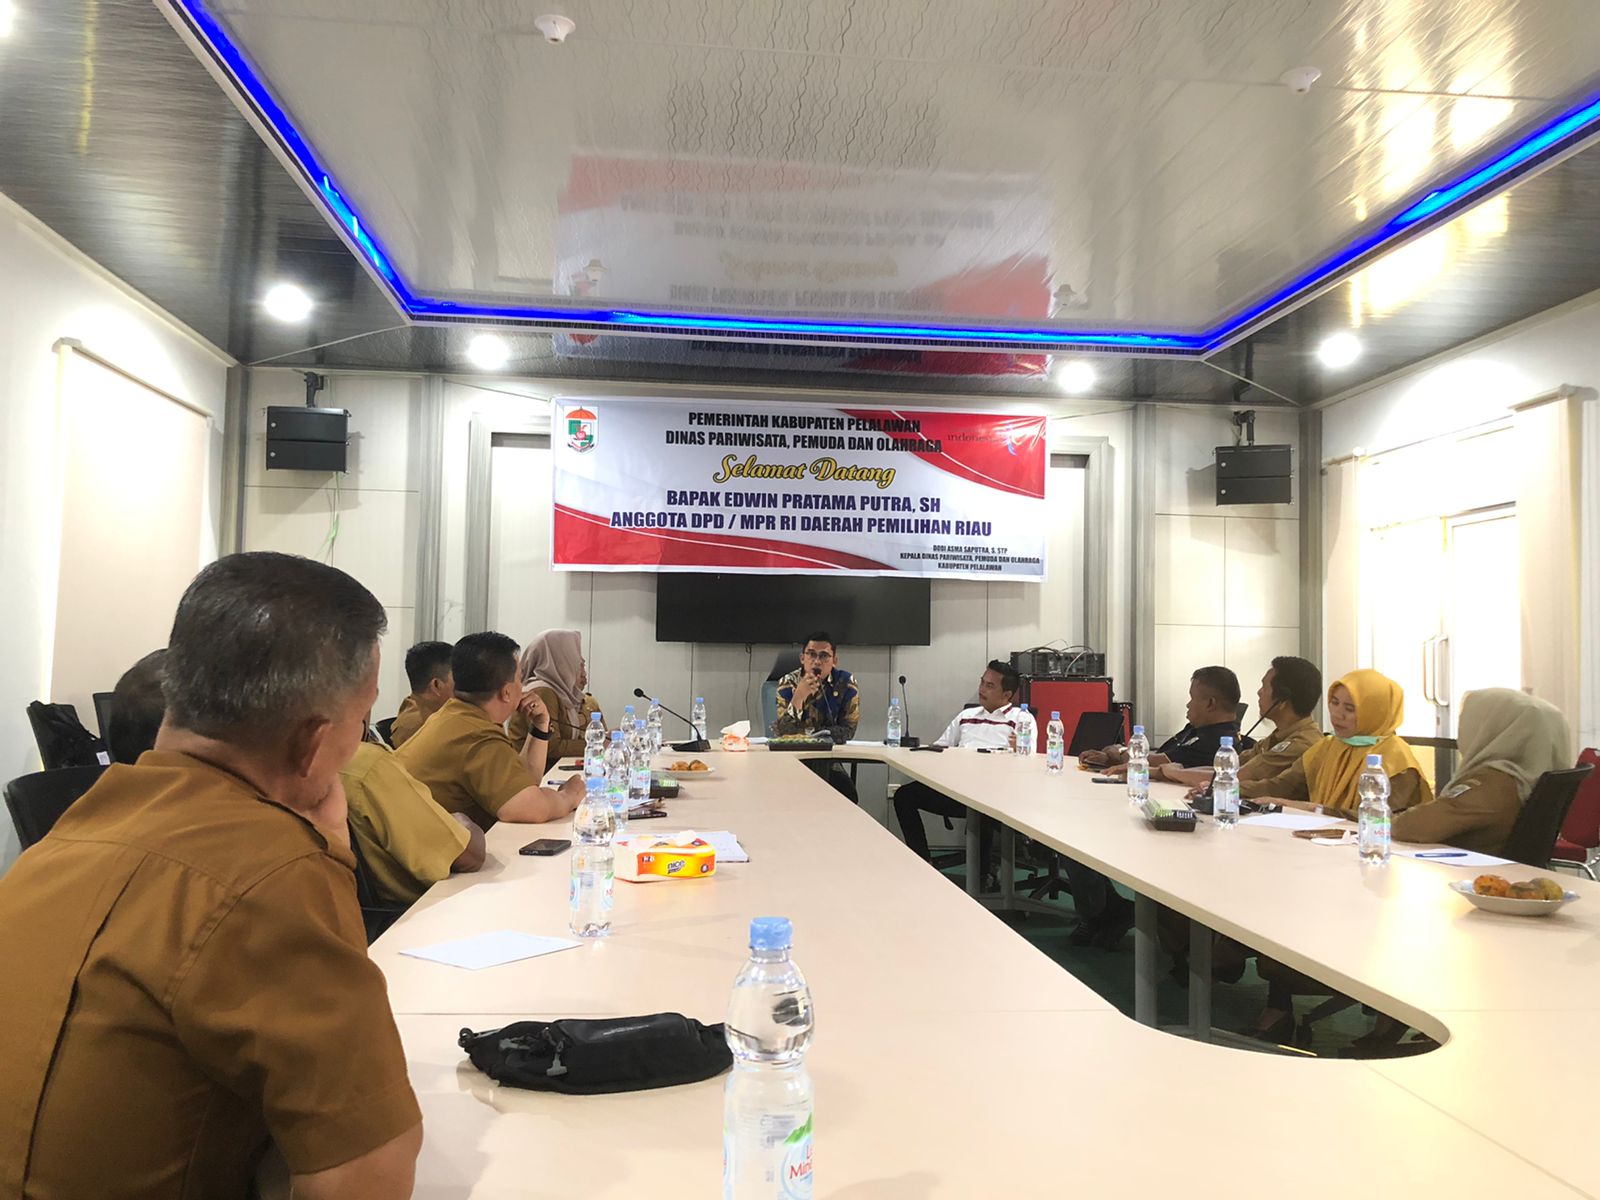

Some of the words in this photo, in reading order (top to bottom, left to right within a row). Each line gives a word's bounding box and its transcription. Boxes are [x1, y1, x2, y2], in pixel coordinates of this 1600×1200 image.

[688, 412, 769, 428] PEMERINTAH
[772, 415, 844, 430] KABUPATEN
[848, 418, 921, 432] PELALAWAN
[666, 430, 705, 445] DINAS
[708, 432, 790, 449] PARIWISATA,
[792, 435, 845, 450] PEMUDA
[848, 437, 873, 451] DAN
[876, 438, 942, 453] OLAHRAGA
[713, 454, 808, 483] Selamat
[809, 457, 896, 489] Datang
[667, 490, 720, 506] BAPAK
[724, 492, 778, 508] EDWIN
[782, 494, 856, 510] PRATAMA
[860, 496, 916, 513] PUTRA,
[919, 498, 941, 513] SH
[611, 512, 687, 528] ANGGOTA
[691, 514, 724, 529] DPD
[728, 514, 737, 529] /
[740, 515, 776, 531] MPR
[780, 515, 796, 531] RI
[800, 516, 863, 533] DAERAH
[867, 518, 951, 535] PEMILIHAN
[955, 520, 992, 537] RIAU
[938, 562, 969, 570] KABUPATEN
